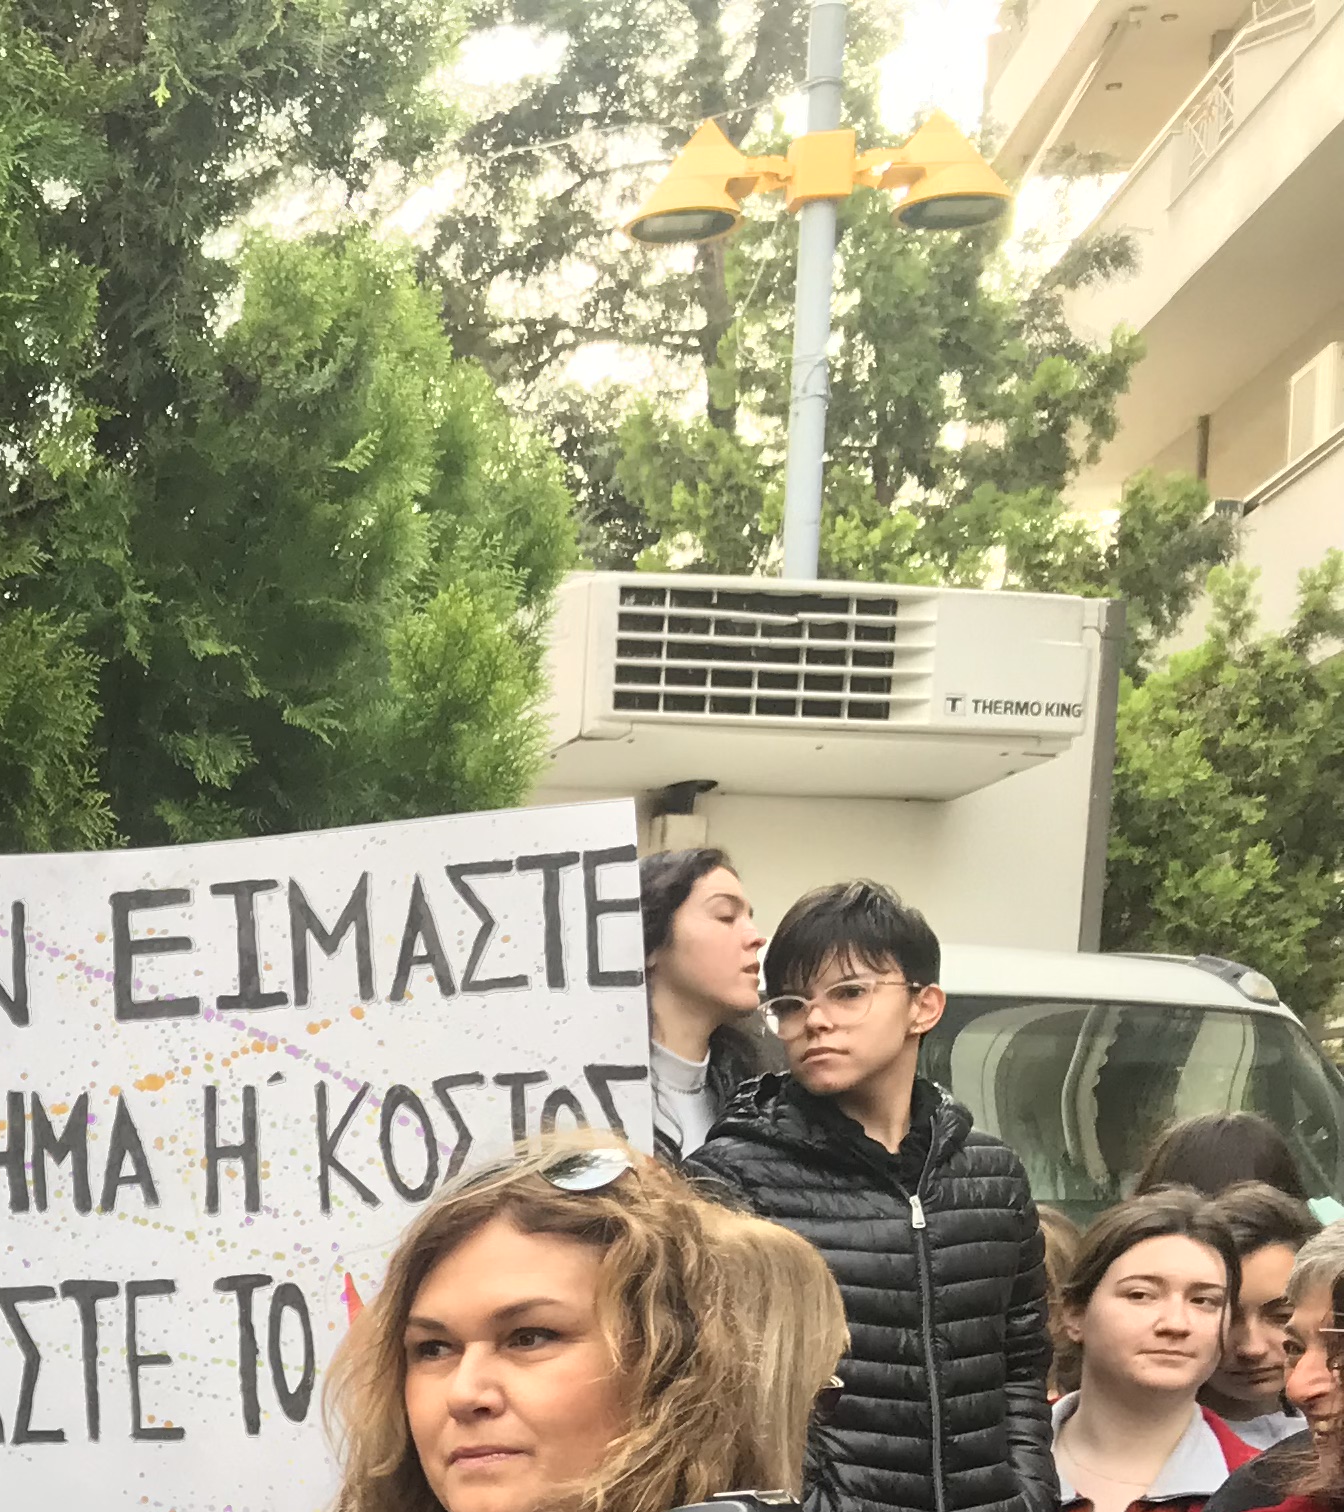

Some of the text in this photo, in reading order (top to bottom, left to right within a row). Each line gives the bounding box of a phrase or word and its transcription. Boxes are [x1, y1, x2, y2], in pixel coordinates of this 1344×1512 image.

[972, 699, 1042, 717] THERMO
[1044, 701, 1084, 718] KING
[111, 845, 642, 1020] ΕΙΜΑΣΤΕ
[217, 1275, 314, 1434] ΤΟ
